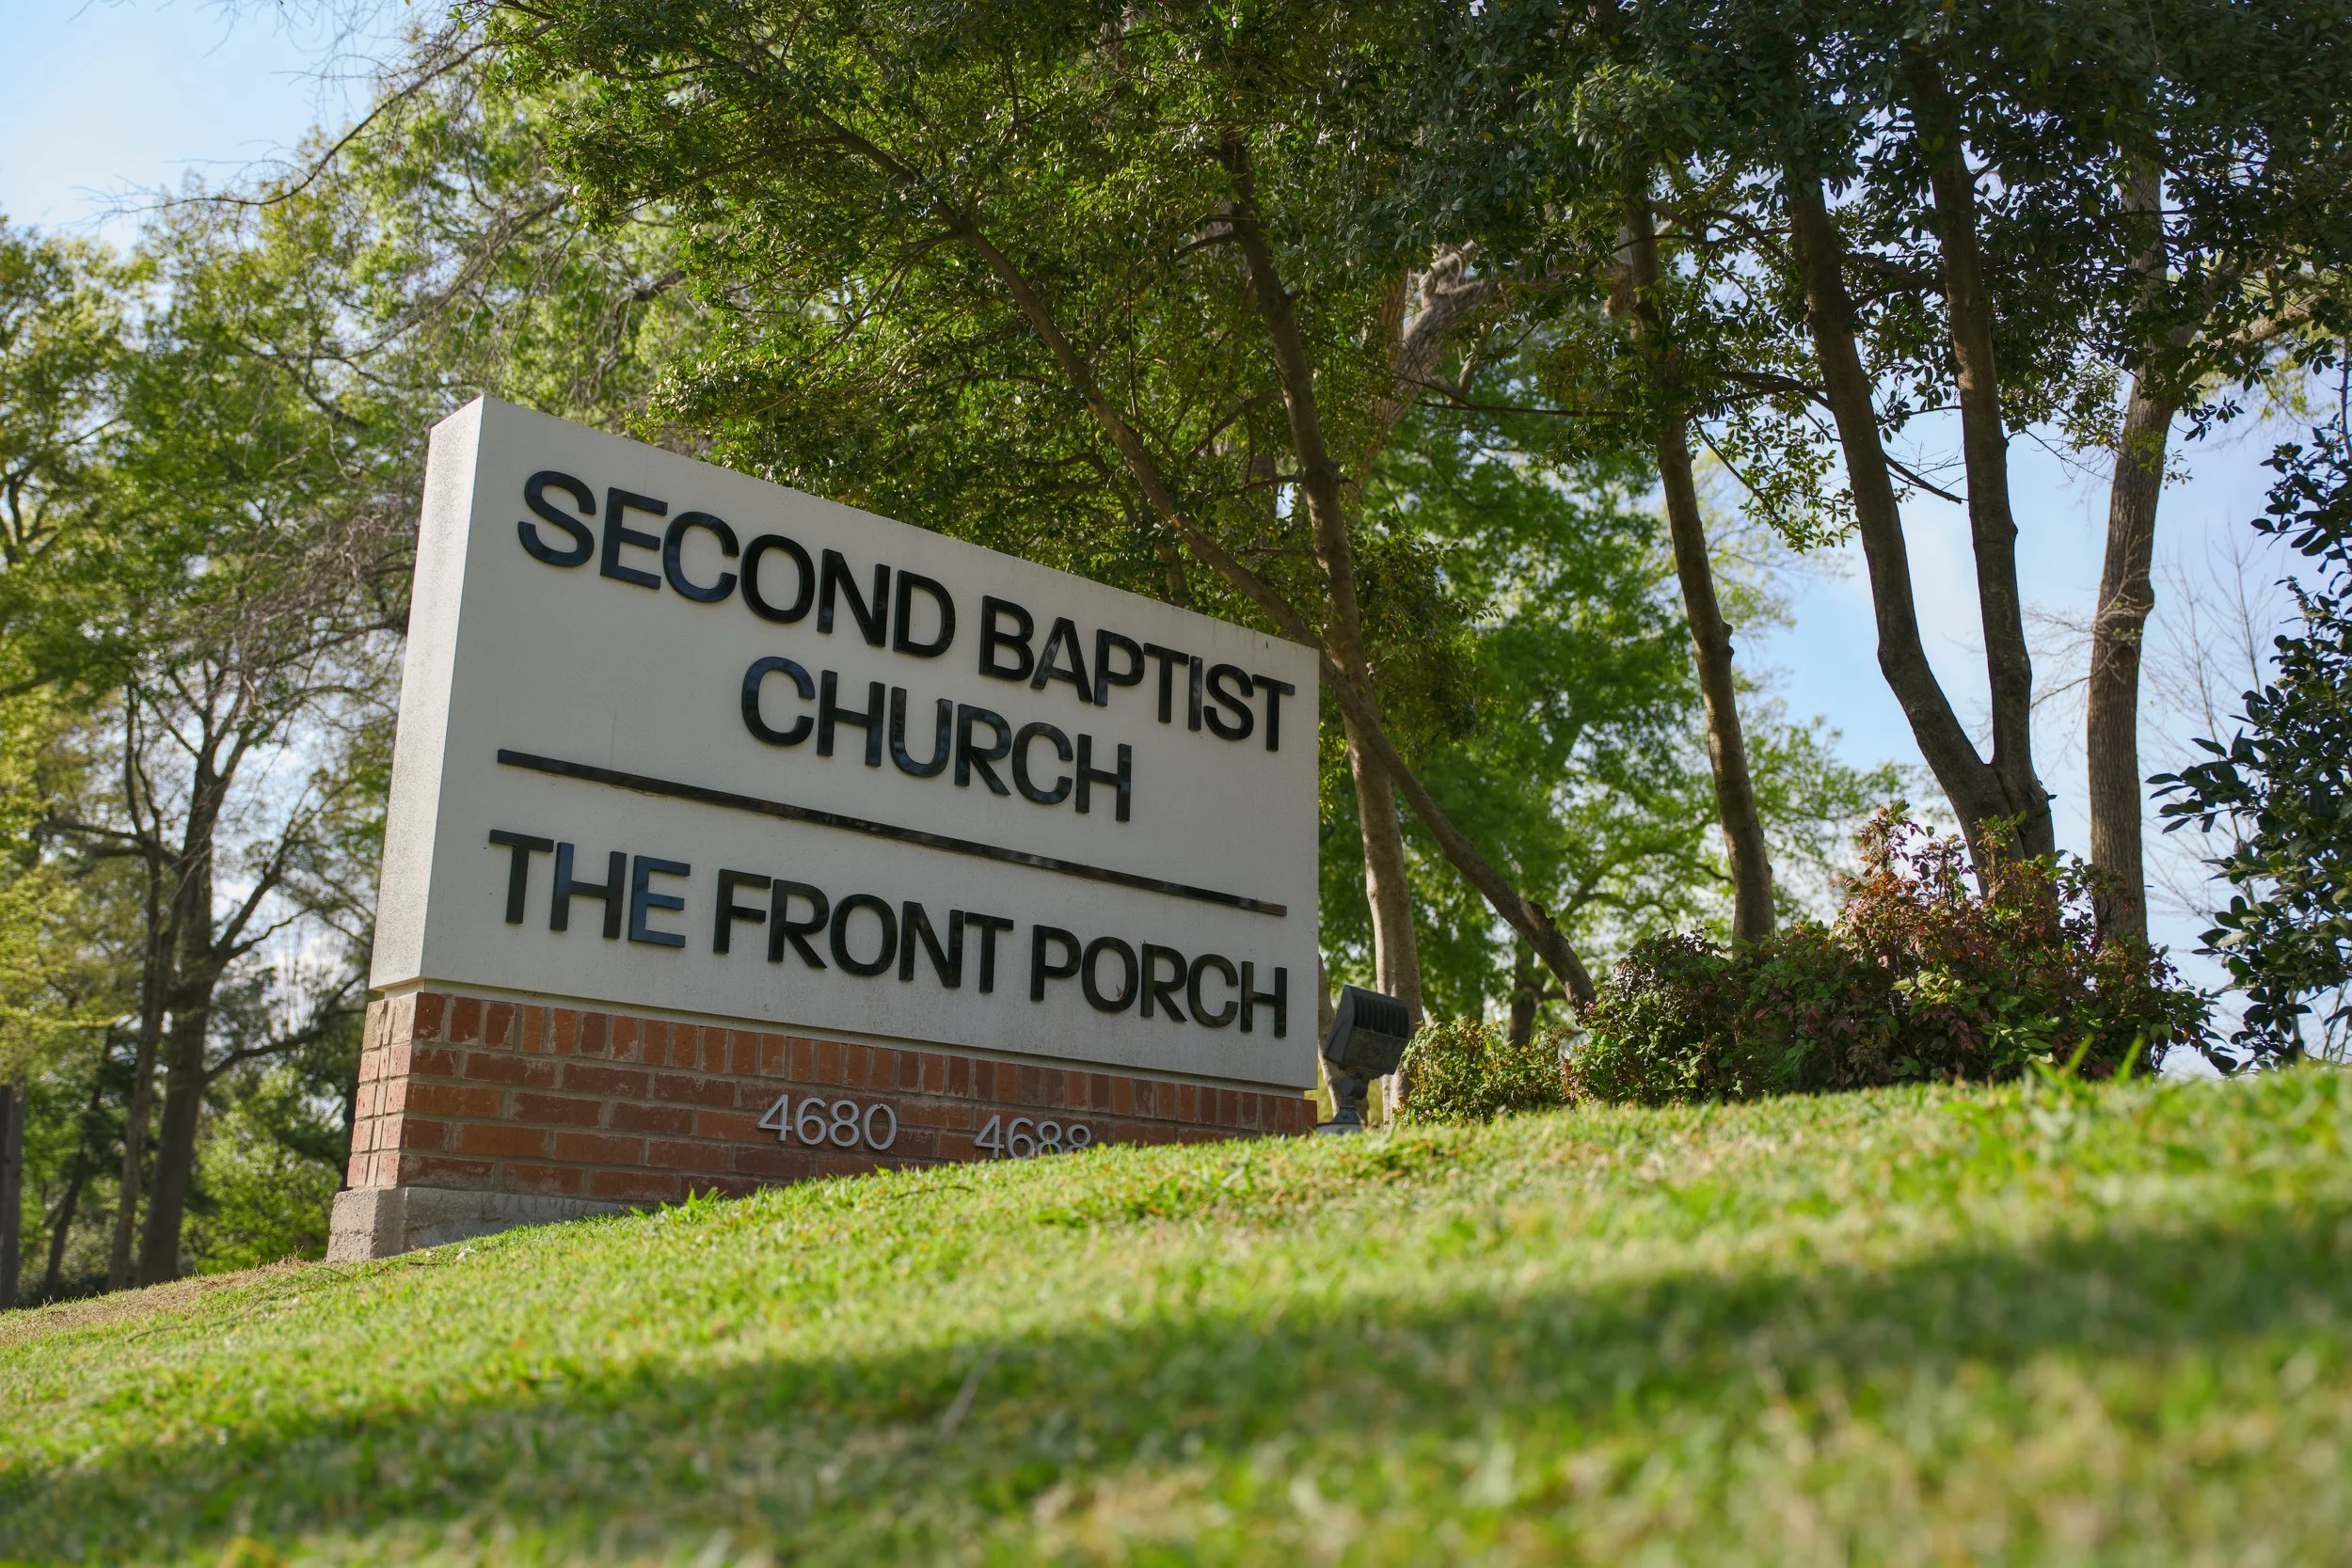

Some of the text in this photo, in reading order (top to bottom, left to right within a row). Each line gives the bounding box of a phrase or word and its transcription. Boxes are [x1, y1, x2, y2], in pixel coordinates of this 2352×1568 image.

[517, 470, 1296, 752] SECOND BAPTIST
[740, 656, 1132, 823] CHURCH
[488, 829, 1288, 1038] THE FRONT PORCH
[757, 1094, 898, 1150] 4680
